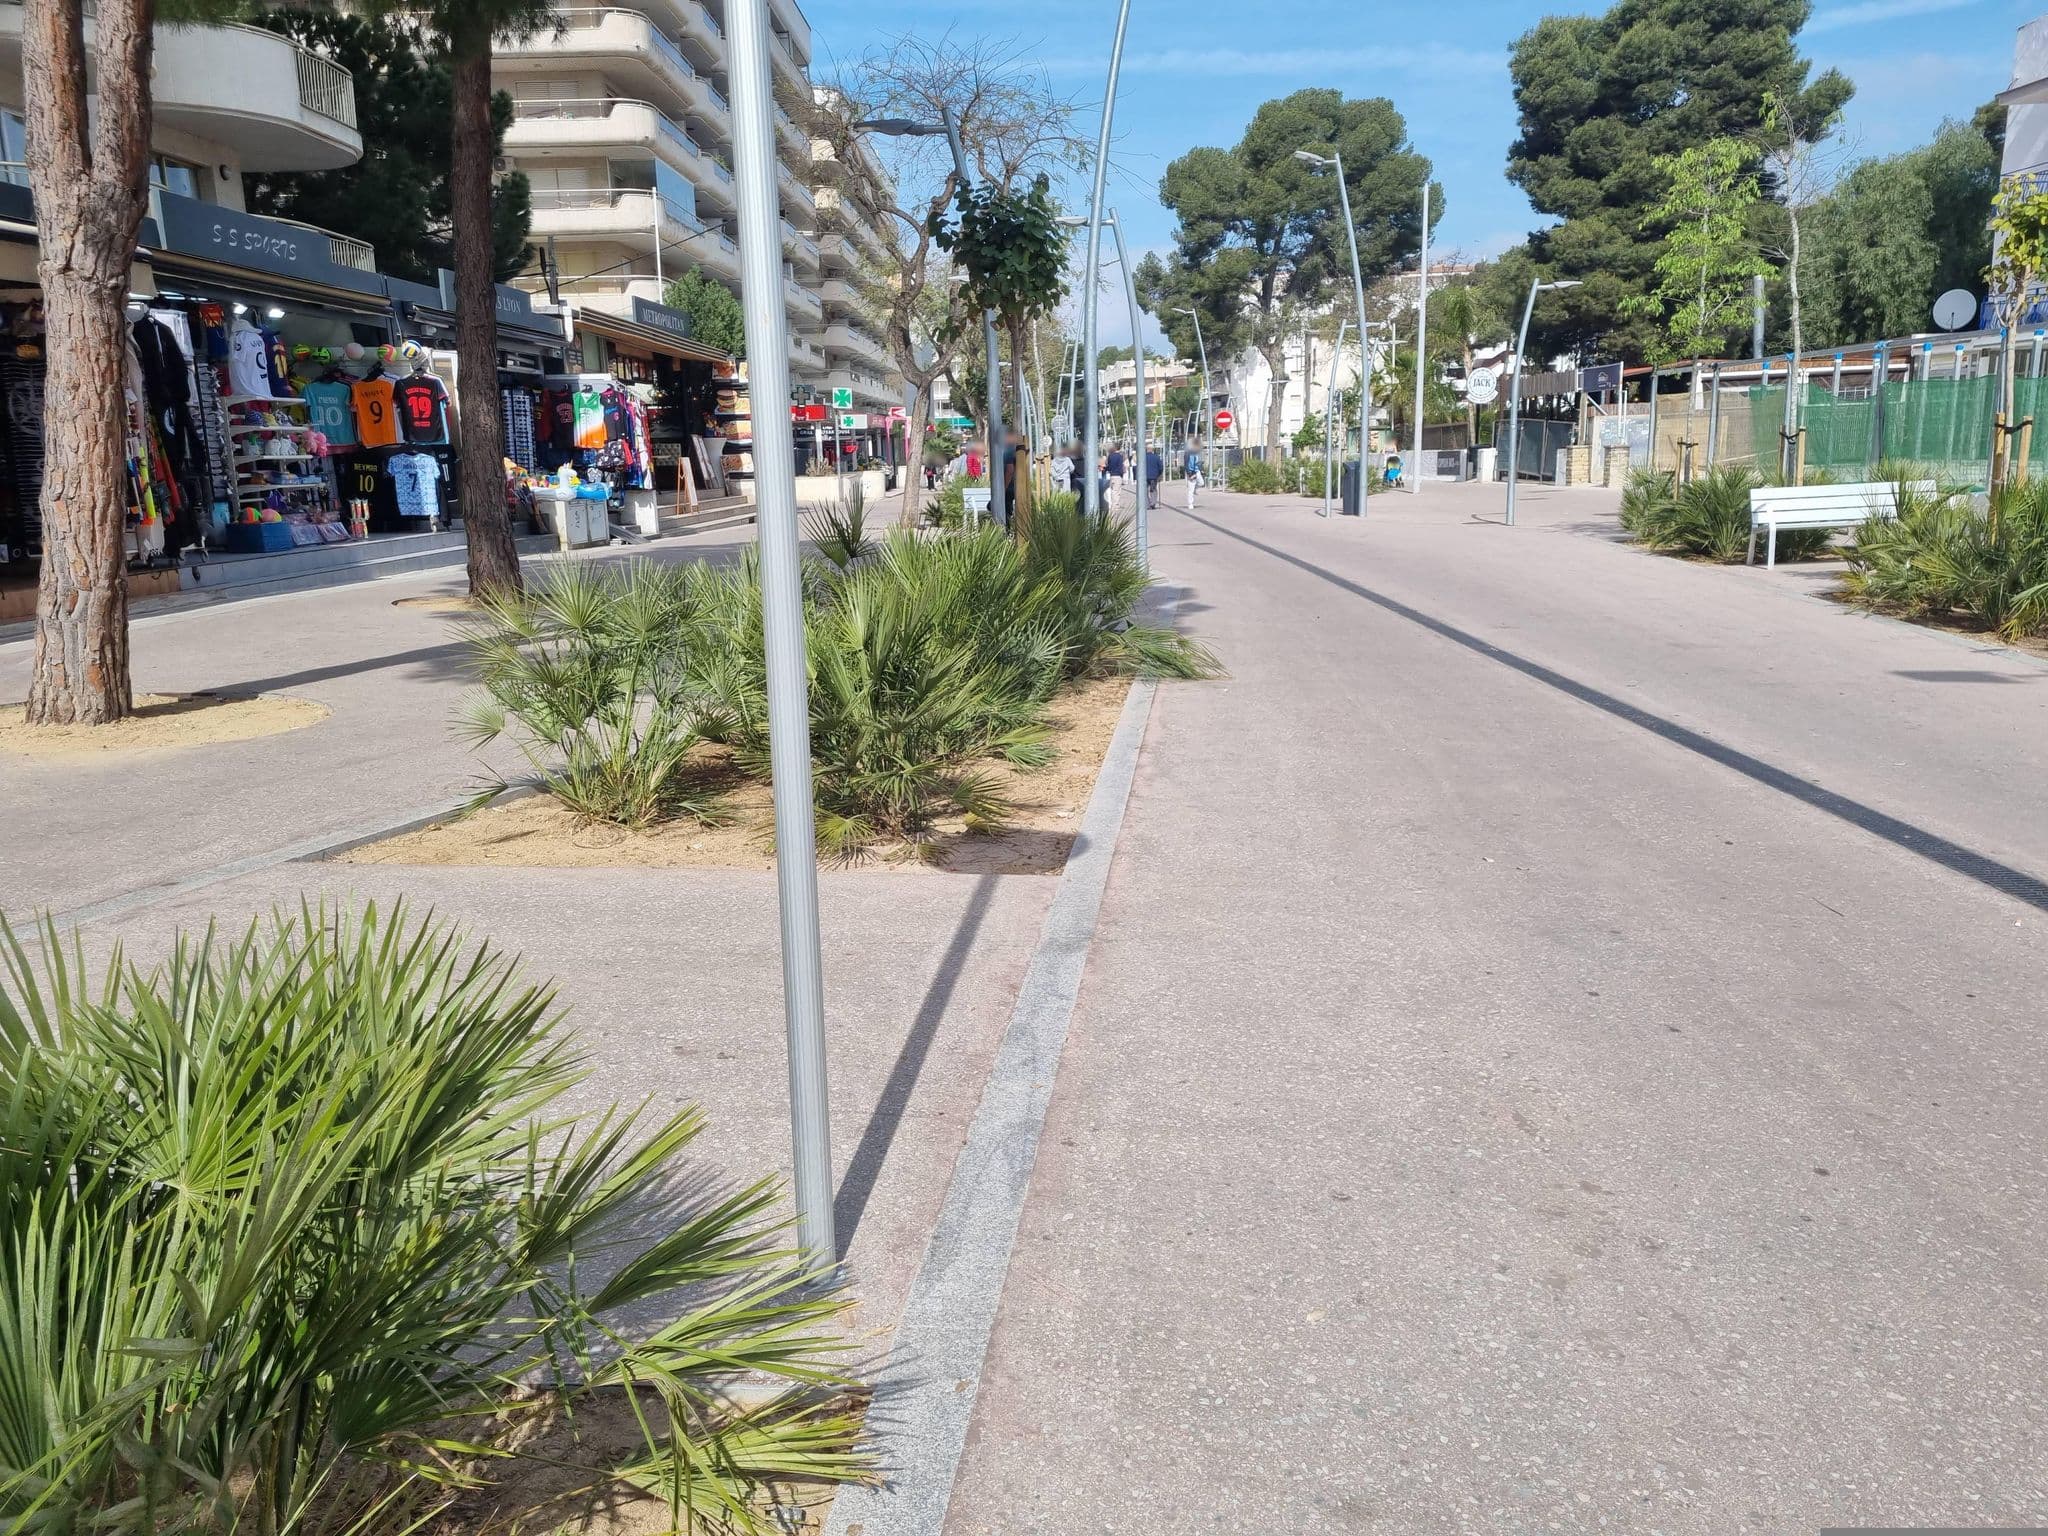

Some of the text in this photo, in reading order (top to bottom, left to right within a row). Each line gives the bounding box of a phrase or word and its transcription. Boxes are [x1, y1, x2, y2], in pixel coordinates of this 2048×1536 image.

[213, 224, 297, 261] S S SPORTS
[641, 307, 685, 332] METROPOLITAN
[1473, 378, 1491, 387] JACK
[369, 400, 384, 425] 9
[408, 396, 432, 419] 19
[353, 463, 378, 472] NEYMAR
[360, 474, 375, 493] 10
[408, 472, 419, 492] 7
